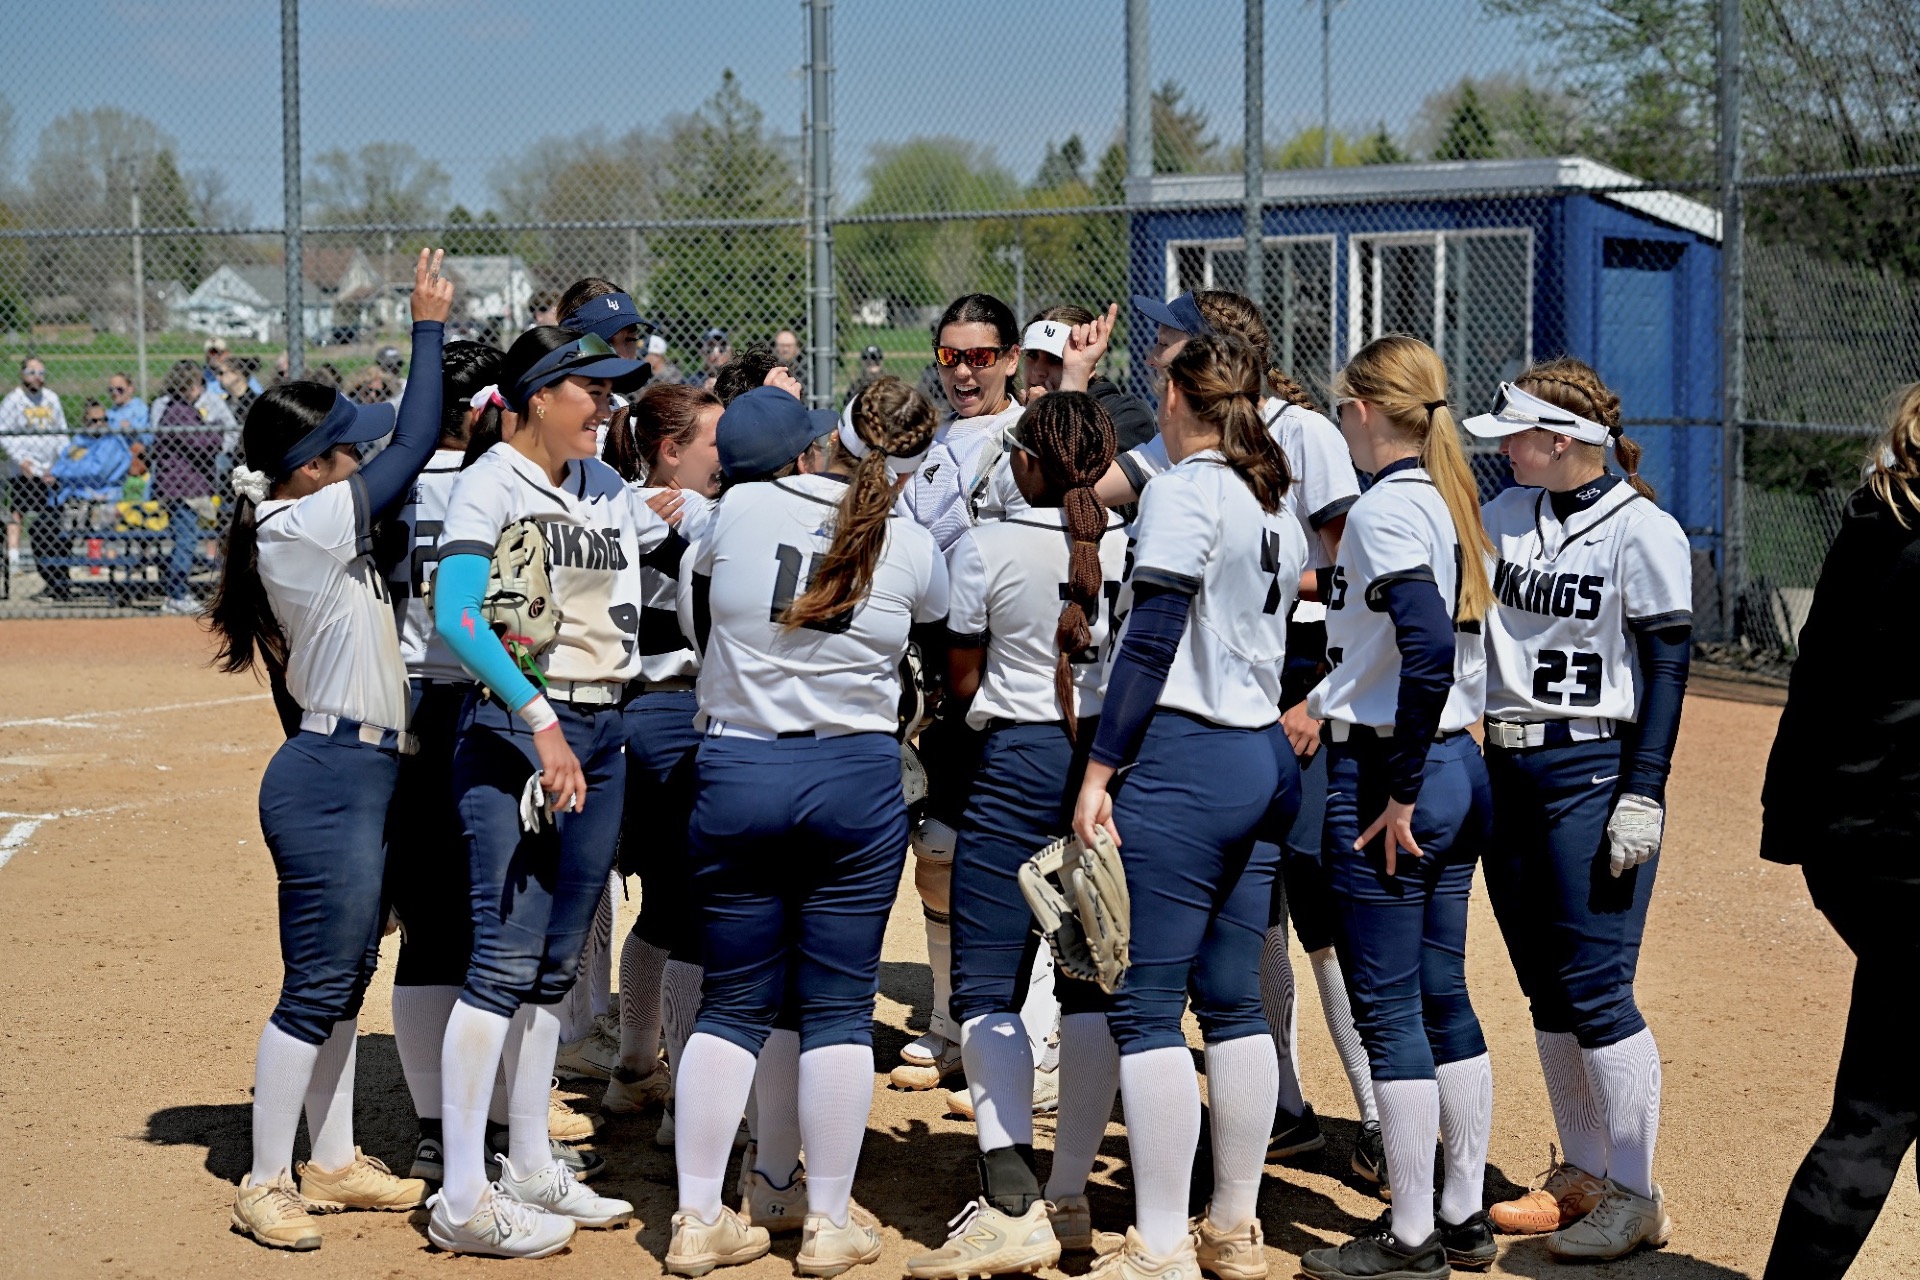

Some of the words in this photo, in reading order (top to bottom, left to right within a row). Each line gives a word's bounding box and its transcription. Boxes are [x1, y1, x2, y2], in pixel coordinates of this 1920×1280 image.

[606, 298, 620, 311] LU
[1043, 324, 1056, 338] LU
[1260, 526, 1282, 616] 4
[1493, 557, 1605, 622] VIKINGS
[1532, 648, 1603, 708] 23
